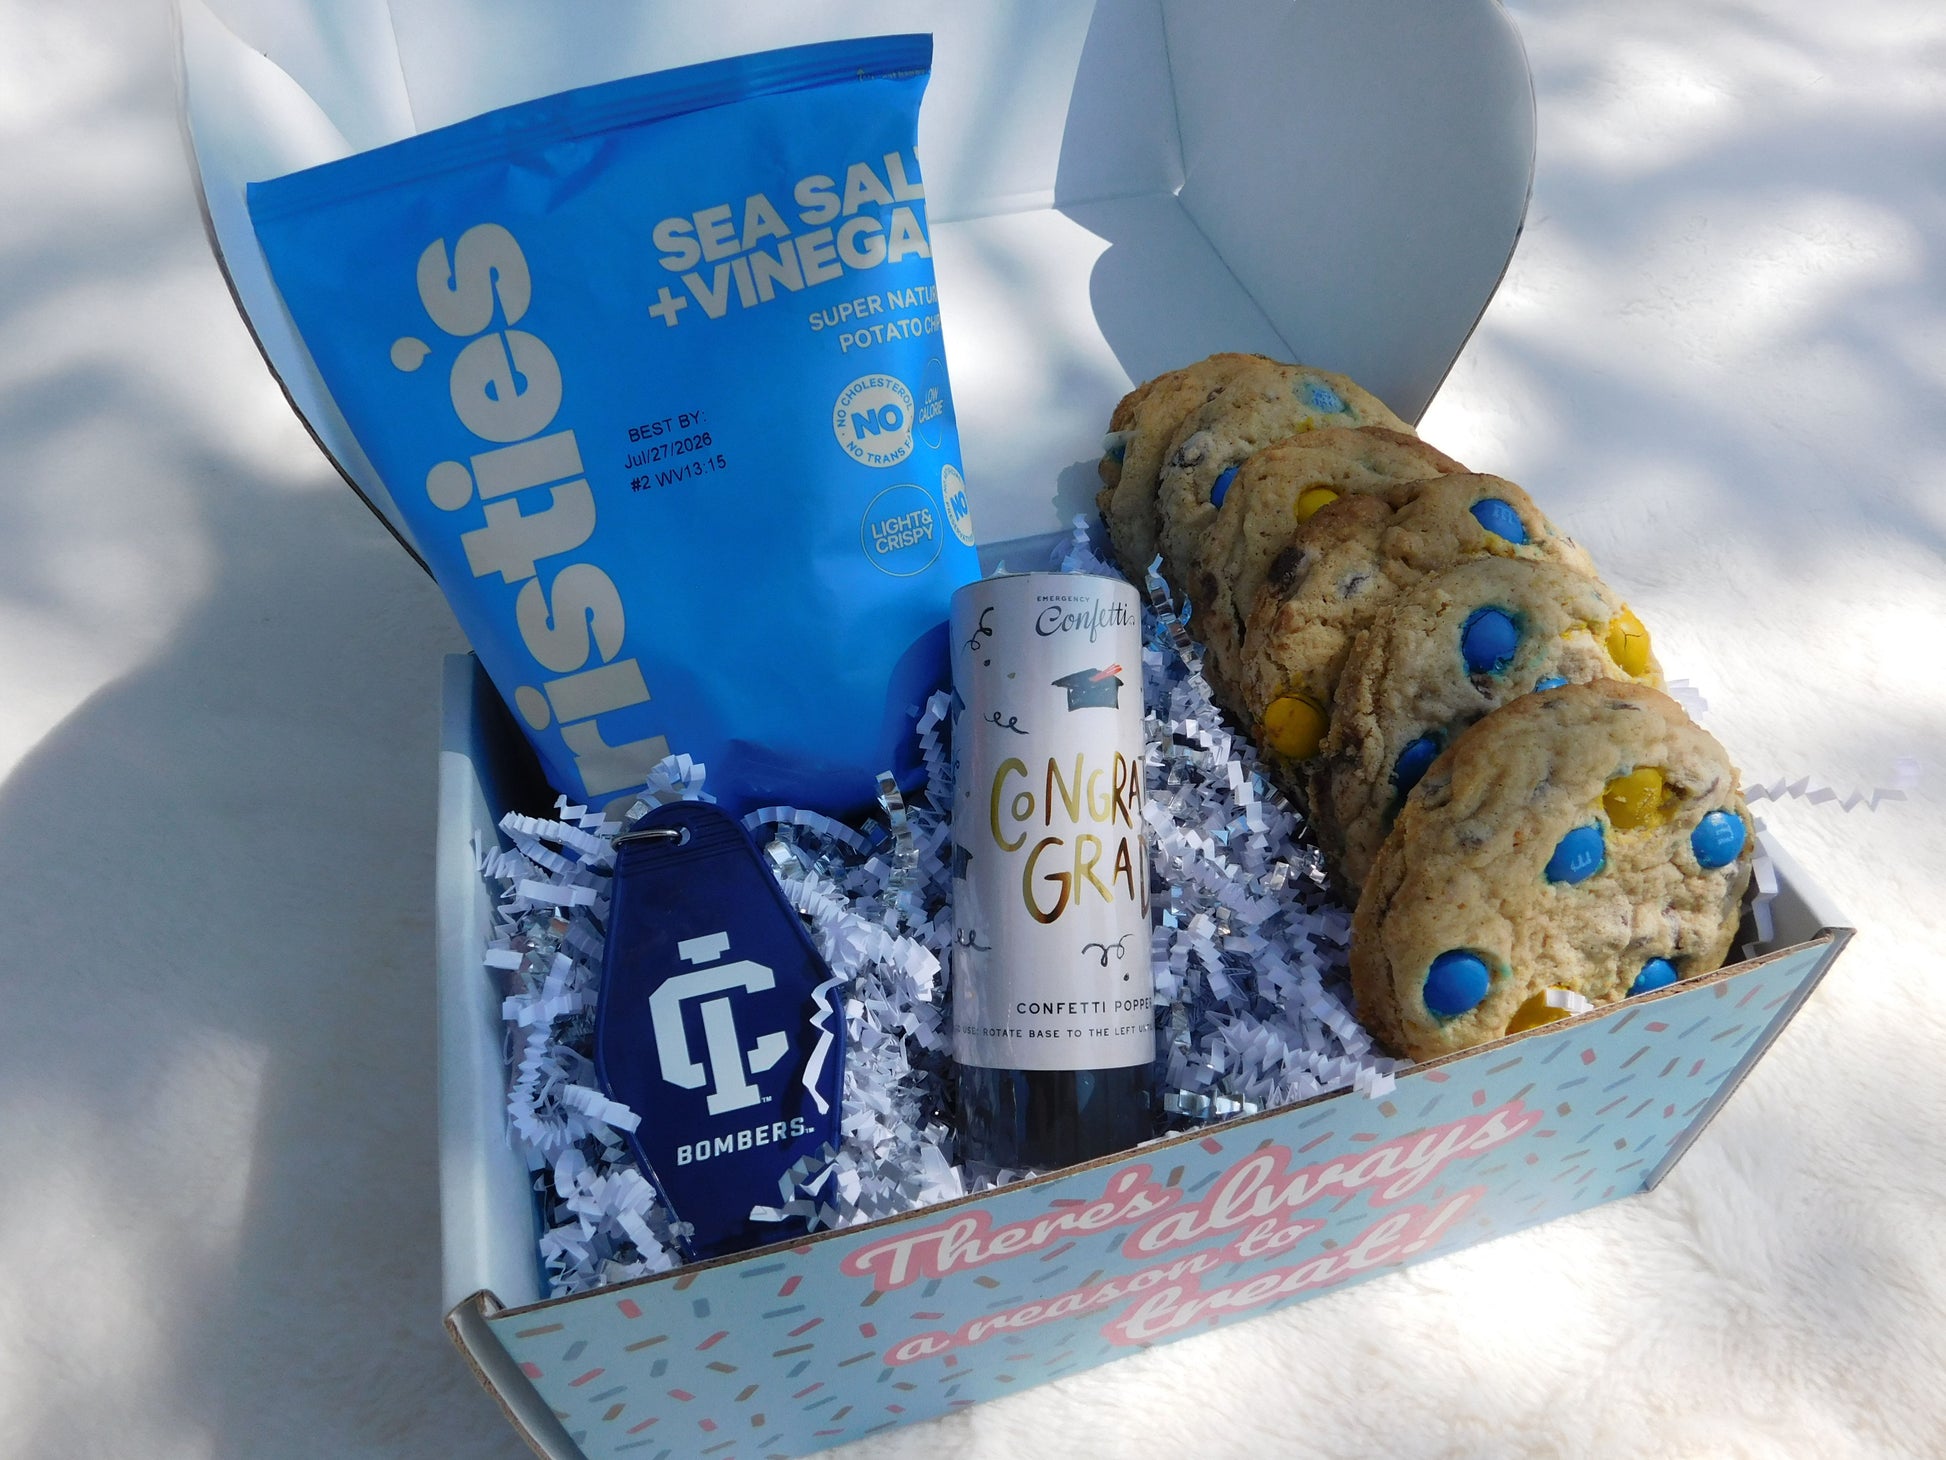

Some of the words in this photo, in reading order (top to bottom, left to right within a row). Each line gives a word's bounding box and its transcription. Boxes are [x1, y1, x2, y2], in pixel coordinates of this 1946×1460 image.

[652, 193, 791, 272] SEA
[794, 146, 925, 226] SAL
[648, 204, 931, 328] +VINEGA
[809, 295, 884, 332] SUPER
[839, 318, 922, 352] POTATO
[841, 378, 913, 411] CHOLESTEROL
[925, 387, 939, 405] LOW
[628, 418, 672, 443] BEST
[678, 410, 706, 429] BY:
[837, 409, 847, 428] NO
[851, 404, 904, 440] NO
[625, 432, 712, 469] Jul/27/2026
[847, 441, 863, 457] NO
[867, 447, 906, 464] TRANS
[631, 475, 651, 492] #2
[950, 491, 969, 521] NO
[391, 222, 688, 832] ristie's
[871, 508, 933, 539] LIGHT&
[875, 524, 934, 554] CRISPY
[1037, 595, 1090, 603] EMERGENCY
[1035, 599, 1135, 644] Confetti
[1017, 1001, 1105, 1014] CONFETTI
[983, 1027, 1022, 1038] ROTATE
[1029, 1029, 1060, 1038] BASE
[1067, 1029, 1082, 1038] TO
[1089, 1028, 1109, 1037] THE
[1115, 1026, 1135, 1036] LEFT
[677, 1117, 804, 1166] BOMBERS
[855, 1172, 1169, 1285] There's
[1138, 1110, 1530, 1251] always
[1118, 1190, 1472, 1339] treat!
[896, 1337, 950, 1361] a
[968, 1250, 1219, 1342] reason
[1235, 1217, 1315, 1258] to
